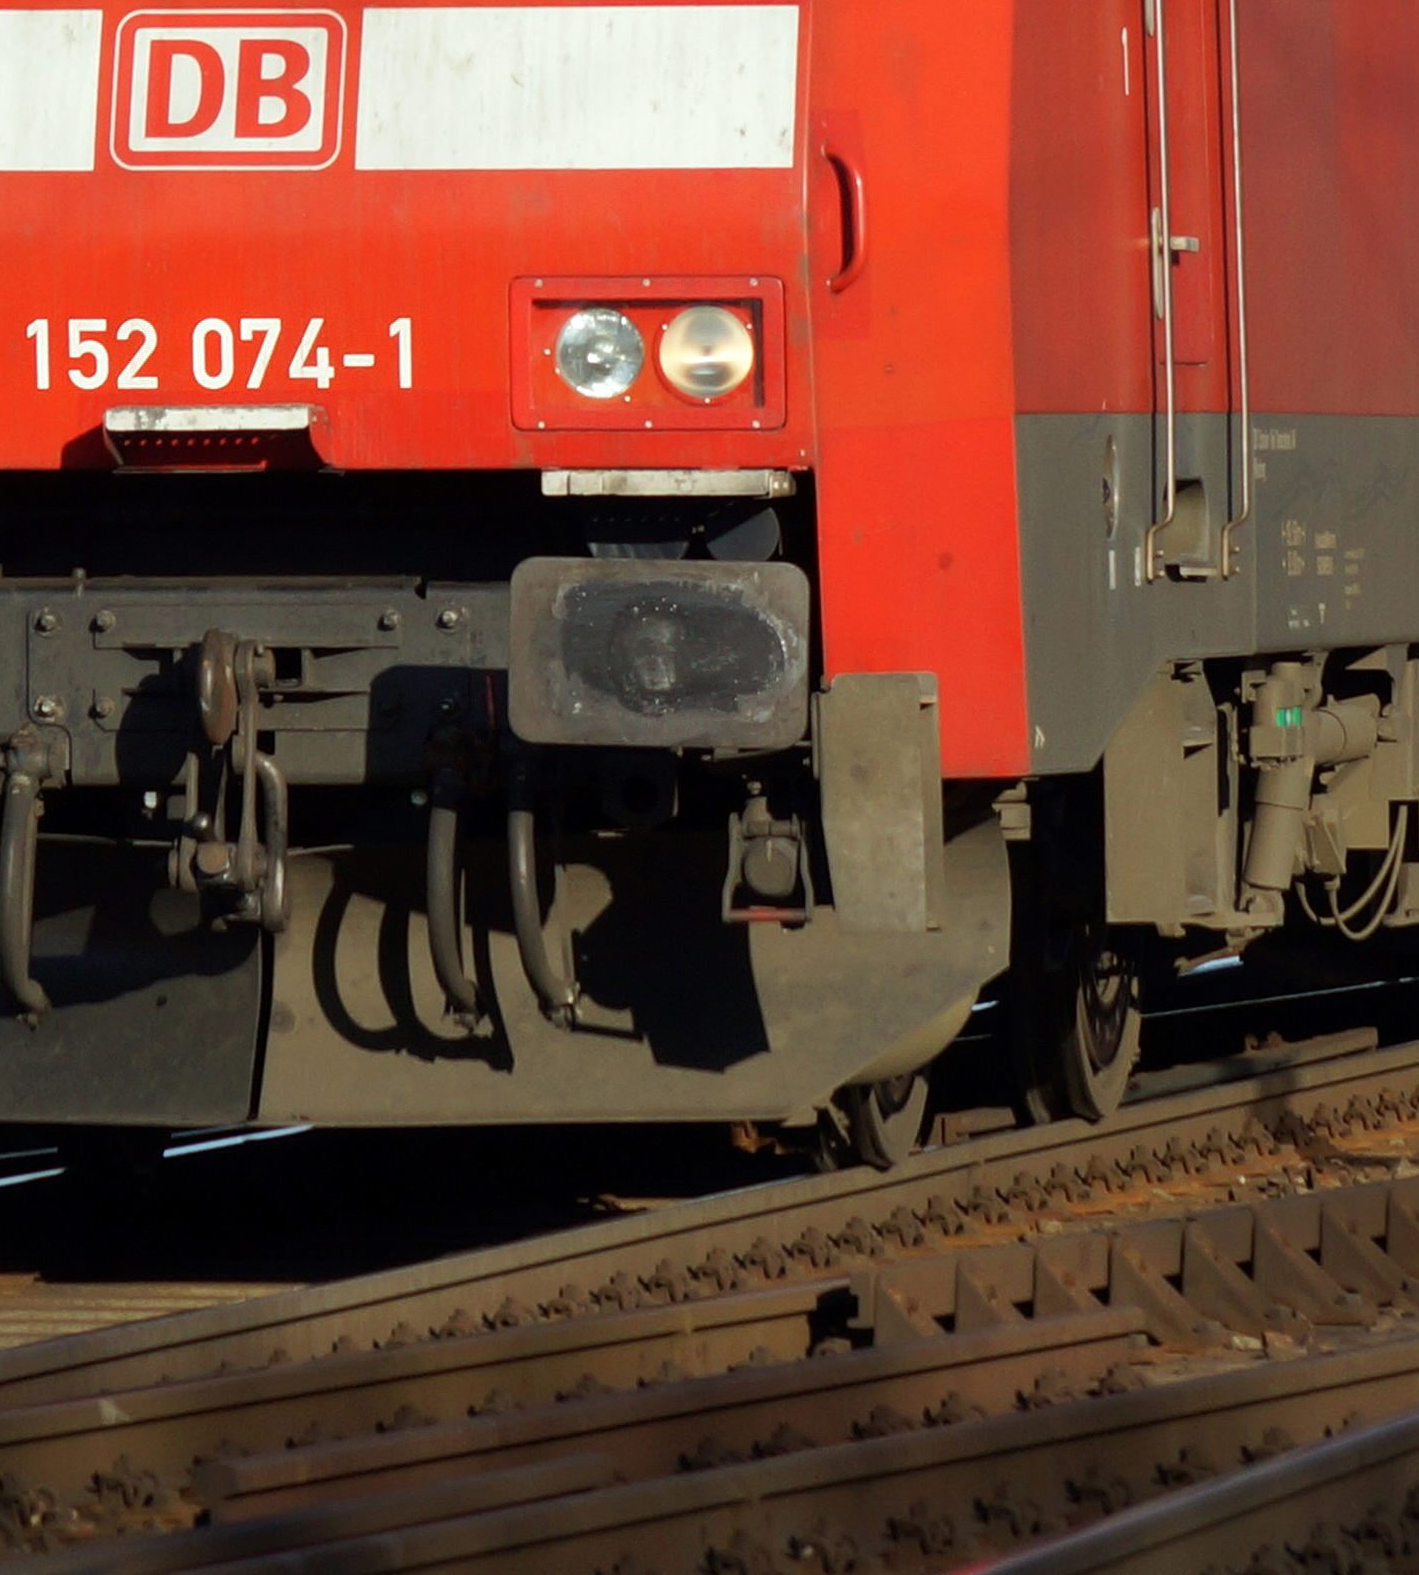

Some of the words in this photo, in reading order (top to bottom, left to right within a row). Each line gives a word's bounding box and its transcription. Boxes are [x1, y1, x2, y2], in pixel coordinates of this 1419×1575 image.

[144, 39, 312, 139] DB
[26, 317, 159, 390] 152
[191, 317, 413, 390] 074-1
